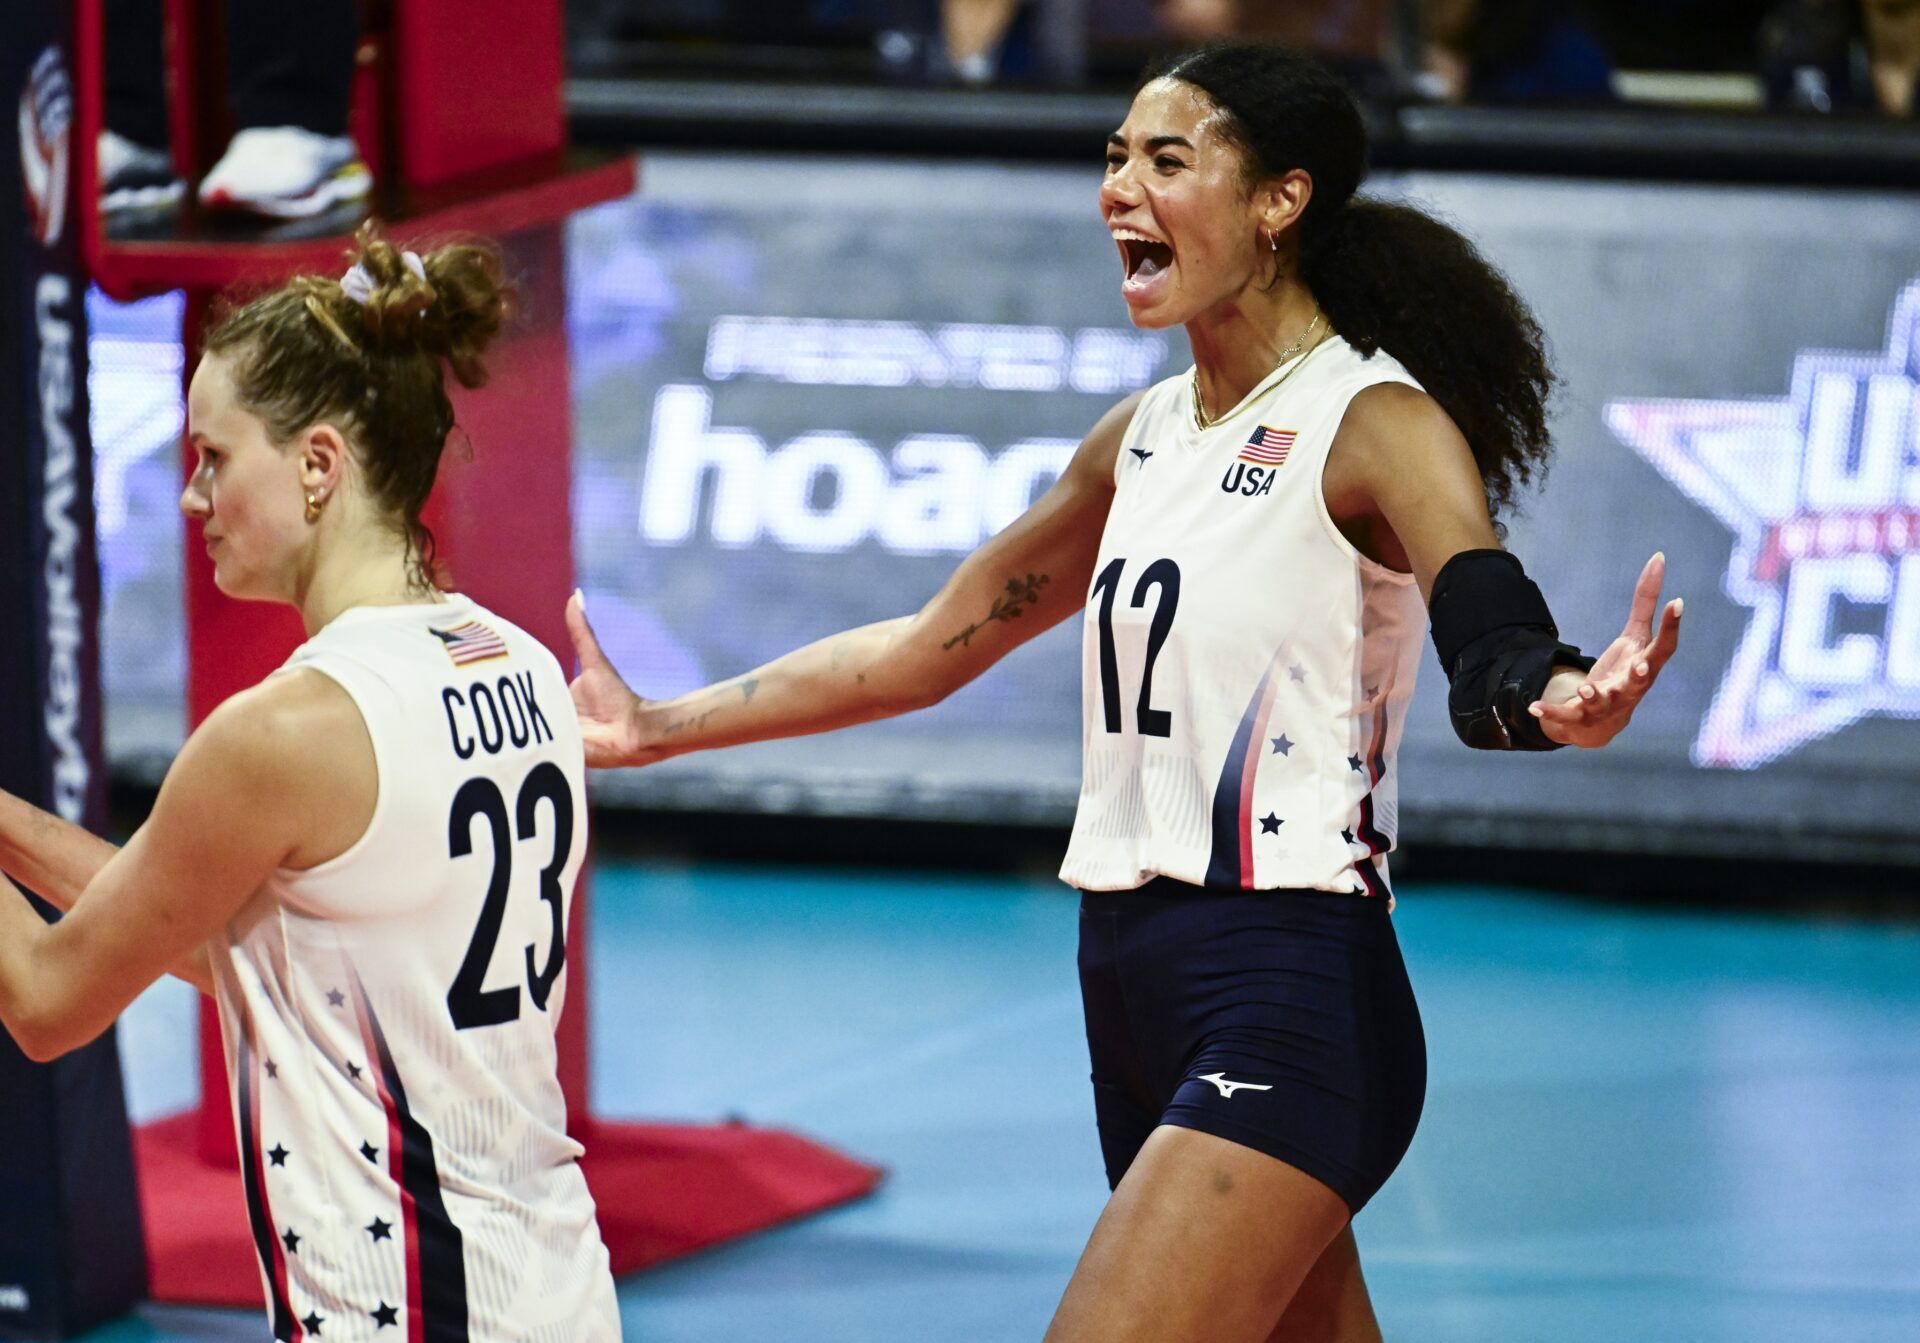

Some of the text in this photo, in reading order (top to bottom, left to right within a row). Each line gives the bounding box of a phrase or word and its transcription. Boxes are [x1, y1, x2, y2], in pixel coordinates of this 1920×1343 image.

[1221, 462, 1277, 497] USA
[1091, 558, 1181, 738] 12
[442, 671, 554, 760] COOK
[446, 761, 574, 1031] 23
